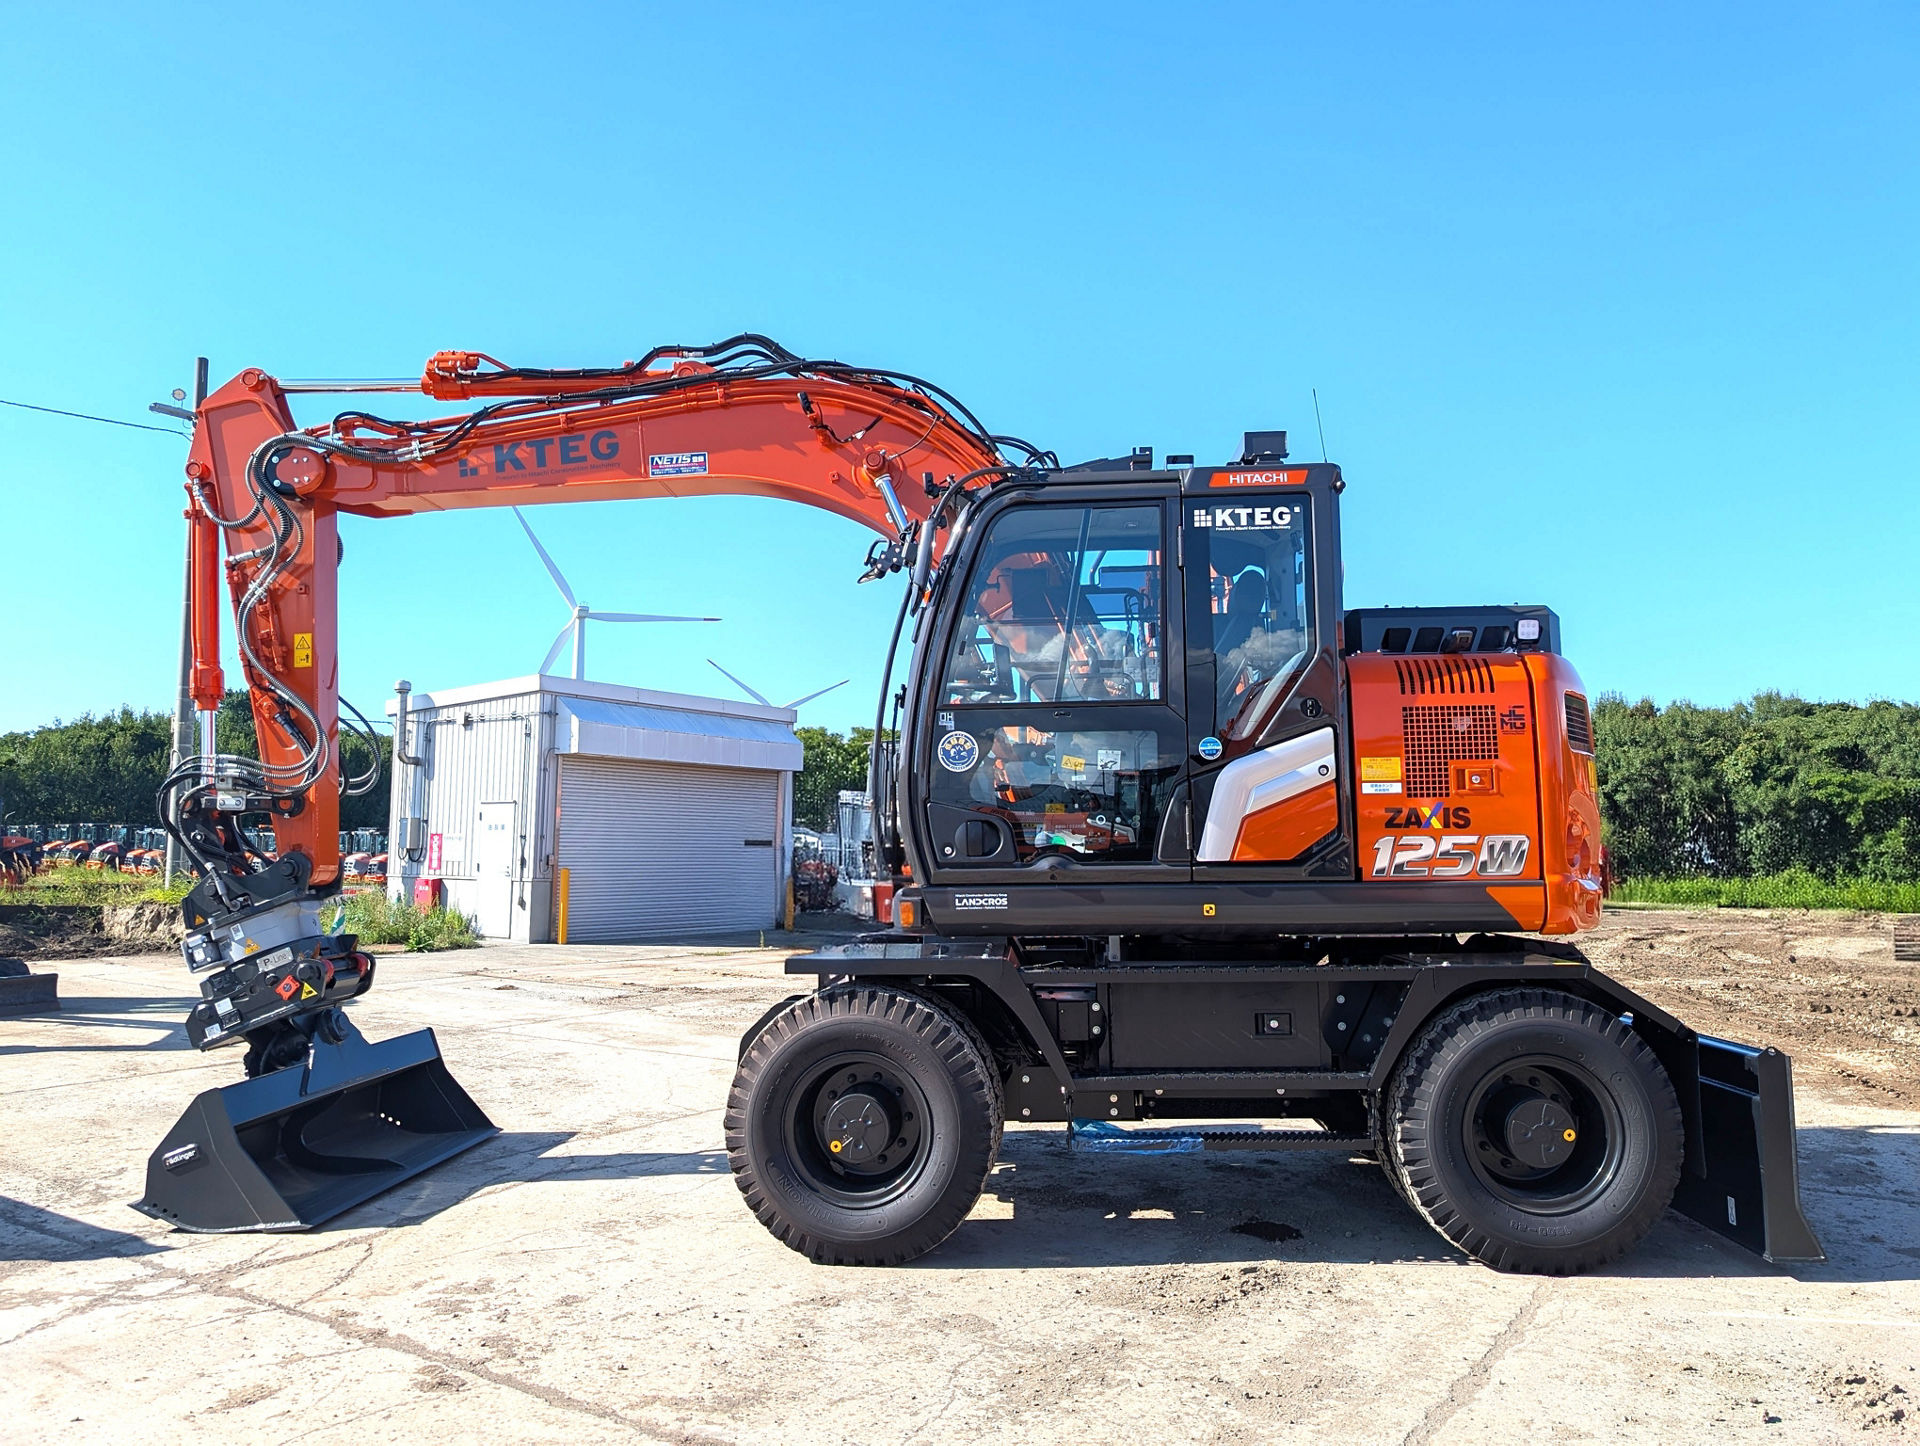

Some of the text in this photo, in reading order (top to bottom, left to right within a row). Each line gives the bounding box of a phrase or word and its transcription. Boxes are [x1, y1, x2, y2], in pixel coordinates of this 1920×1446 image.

[493, 430, 620, 473] KTEG
[653, 455, 691, 466] NETIS
[1229, 472, 1288, 484] HITACHI
[1215, 506, 1291, 527] KTEG
[1384, 802, 1471, 829] ZAXIS
[1372, 835, 1530, 877] 125W
[955, 898, 1008, 906] LANDCROS
